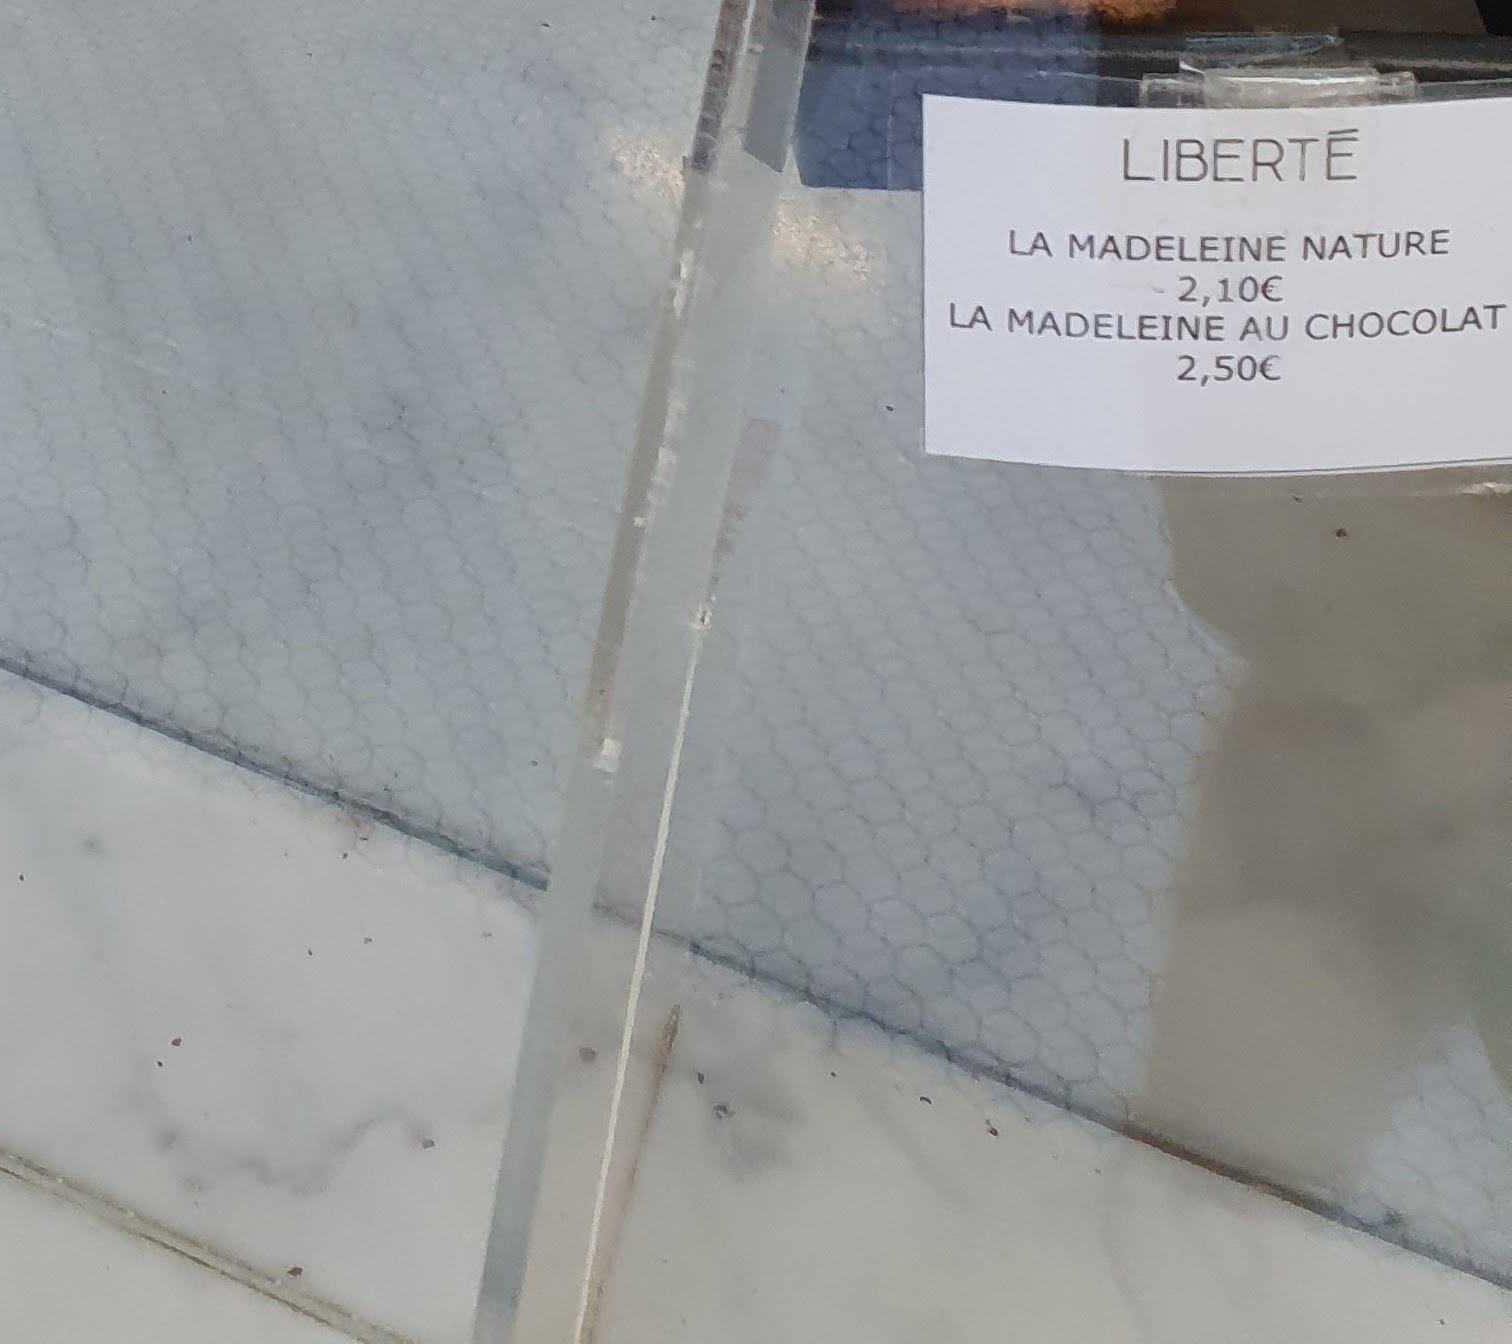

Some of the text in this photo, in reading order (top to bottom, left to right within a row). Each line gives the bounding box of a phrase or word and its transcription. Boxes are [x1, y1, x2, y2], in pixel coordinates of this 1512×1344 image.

[1122, 128, 1359, 183] LIBERTÉ
[1009, 229, 1451, 262] LA MADELEINE NATURE
[1177, 275, 1284, 309] 2,10€
[949, 302, 1508, 343] LA MADELEINE AU CHOCOLAT
[1177, 354, 1283, 388] 2,50€
